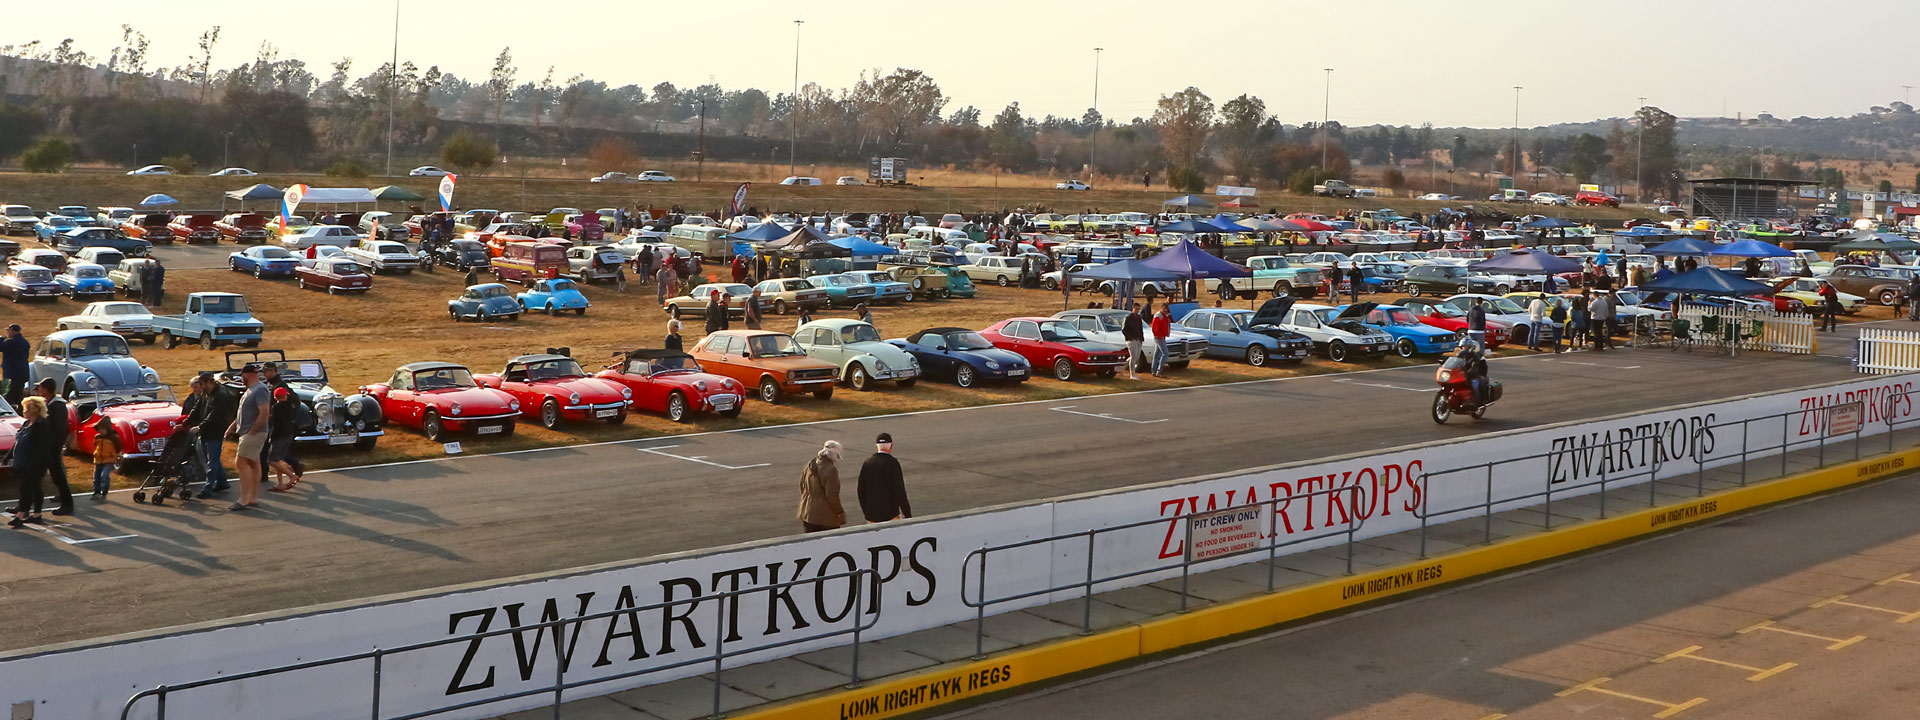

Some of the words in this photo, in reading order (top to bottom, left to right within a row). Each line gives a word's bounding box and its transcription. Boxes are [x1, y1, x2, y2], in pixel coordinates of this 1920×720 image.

[1551, 413, 1715, 484] ZWARTKOPS
[1194, 519, 1208, 529] PIT
[1211, 515, 1235, 526] CREW
[1238, 510, 1260, 521] ONLY
[1651, 512, 1666, 527] LOOK
[1668, 508, 1685, 522] RIGHT
[1685, 505, 1698, 518] KYK
[1700, 501, 1717, 514] REGS
[1219, 525, 1242, 533] SMOKING
[1227, 532, 1256, 542] BEVERAGES
[1206, 547, 1229, 556] PERSONS
[1342, 581, 1365, 600] LOOK
[1368, 575, 1393, 595] RIGHT
[1394, 572, 1413, 588] KYK
[1417, 564, 1442, 583] REGS
[445, 537, 937, 696] ZWARTKOPS
[840, 695, 879, 720] LOOK
[884, 685, 927, 712] RIGHT
[930, 677, 961, 701] KYK
[968, 665, 1011, 691] REGS
